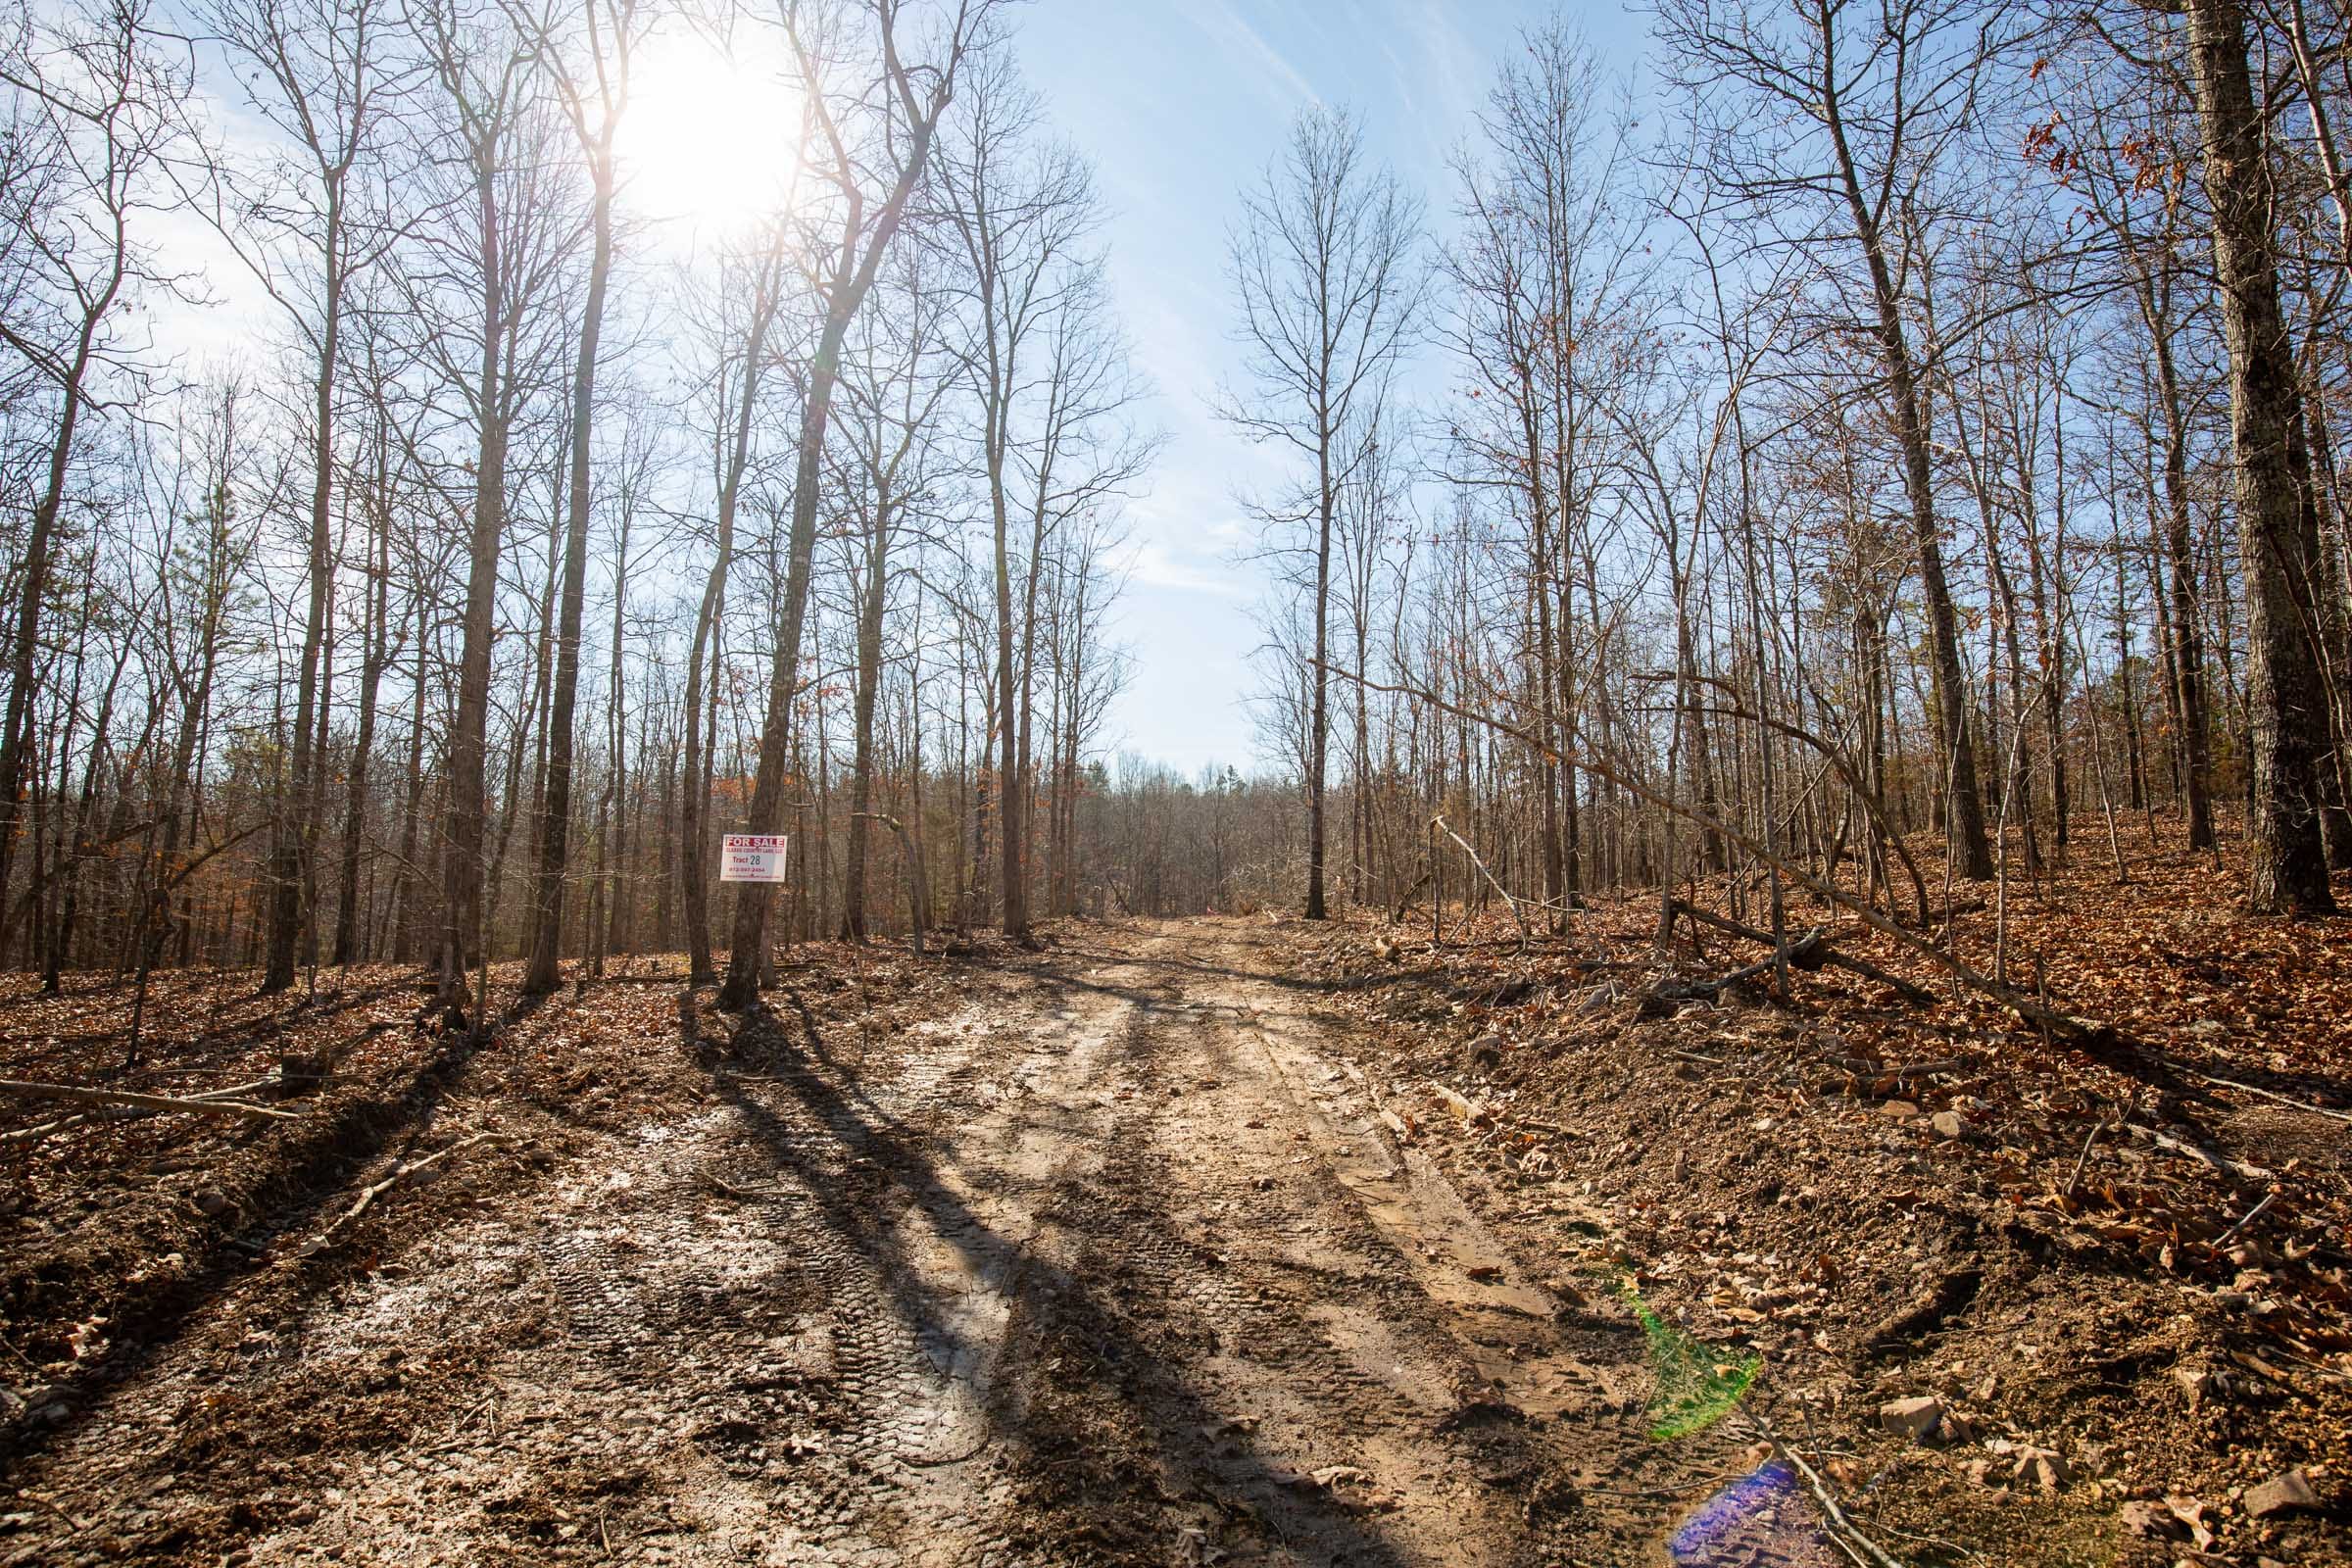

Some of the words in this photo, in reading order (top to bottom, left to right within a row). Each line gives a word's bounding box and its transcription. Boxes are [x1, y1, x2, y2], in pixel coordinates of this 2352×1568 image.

[726, 838, 750, 847] FOR
[754, 838, 784, 847] SALE
[750, 855, 760, 865] 28
